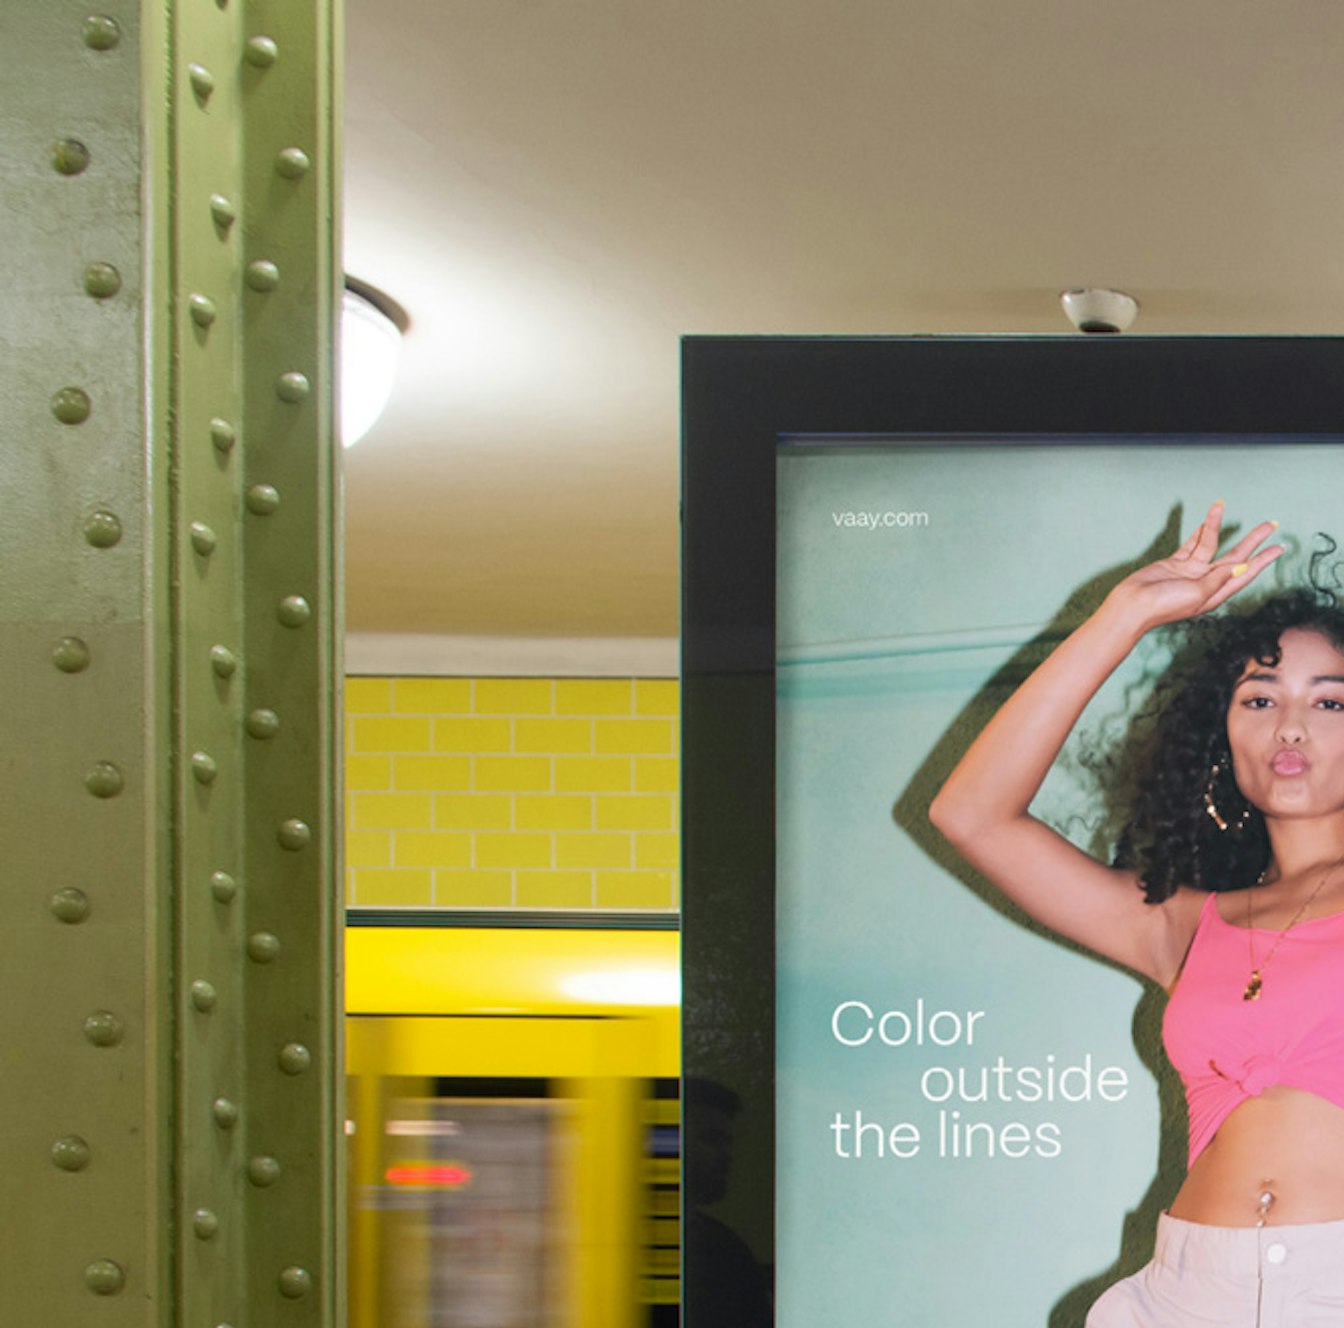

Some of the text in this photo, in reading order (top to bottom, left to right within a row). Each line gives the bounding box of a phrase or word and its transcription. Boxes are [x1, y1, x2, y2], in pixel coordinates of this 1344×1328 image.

[832, 510, 929, 531] vaay.com
[831, 998, 985, 1046] Color
[920, 1053, 1130, 1102] outside
[830, 1110, 1063, 1158] the lines
